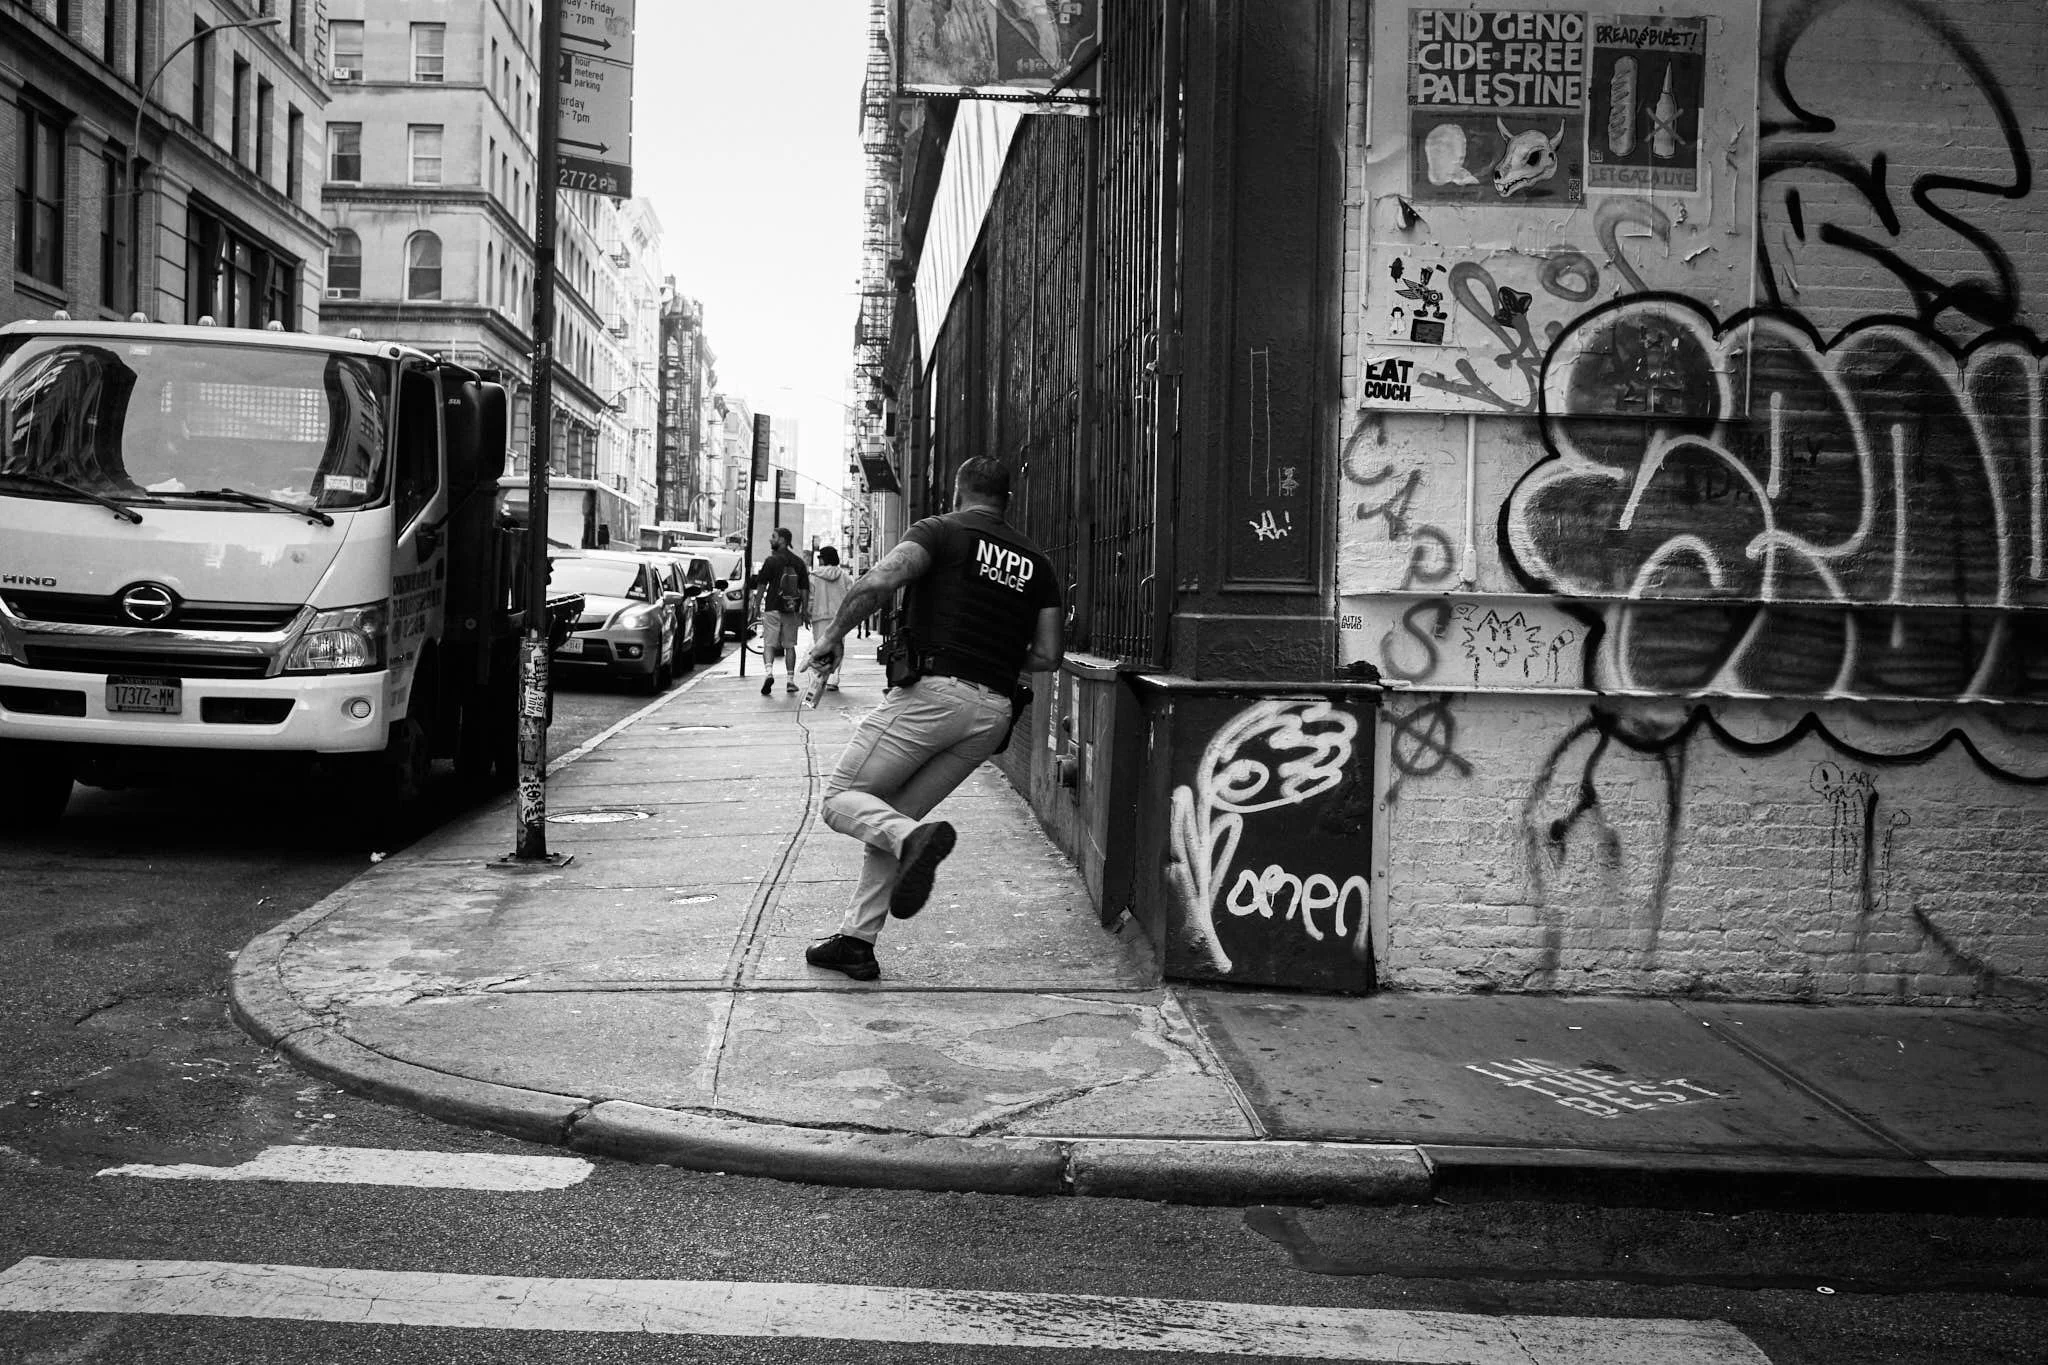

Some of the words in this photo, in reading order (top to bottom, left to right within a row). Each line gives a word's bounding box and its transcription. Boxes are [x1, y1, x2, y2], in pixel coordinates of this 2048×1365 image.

[590, 0, 615, 17] Friday
[576, 13, 595, 24] 7pm
[1417, 10, 1484, 41] END
[1492, 11, 1584, 41] GENO
[1596, 25, 1638, 44] BREAD
[575, 56, 591, 67] hour
[574, 68, 604, 81] metered
[574, 79, 601, 92] parking
[1417, 72, 1583, 106] PALESTINE
[572, 110, 590, 124] 7pm
[560, 168, 597, 190] 2772
[1591, 167, 1616, 182] LET
[1618, 167, 1661, 185] GAZA
[1664, 170, 1694, 186] LIVE
[1365, 358, 1414, 384] EAT
[1364, 381, 1411, 401] COUCH
[976, 539, 1033, 581] NYPD
[2, 574, 57, 587] HINO
[979, 563, 1026, 592] POLICE
[1555, 1078, 1720, 1117] BEST
